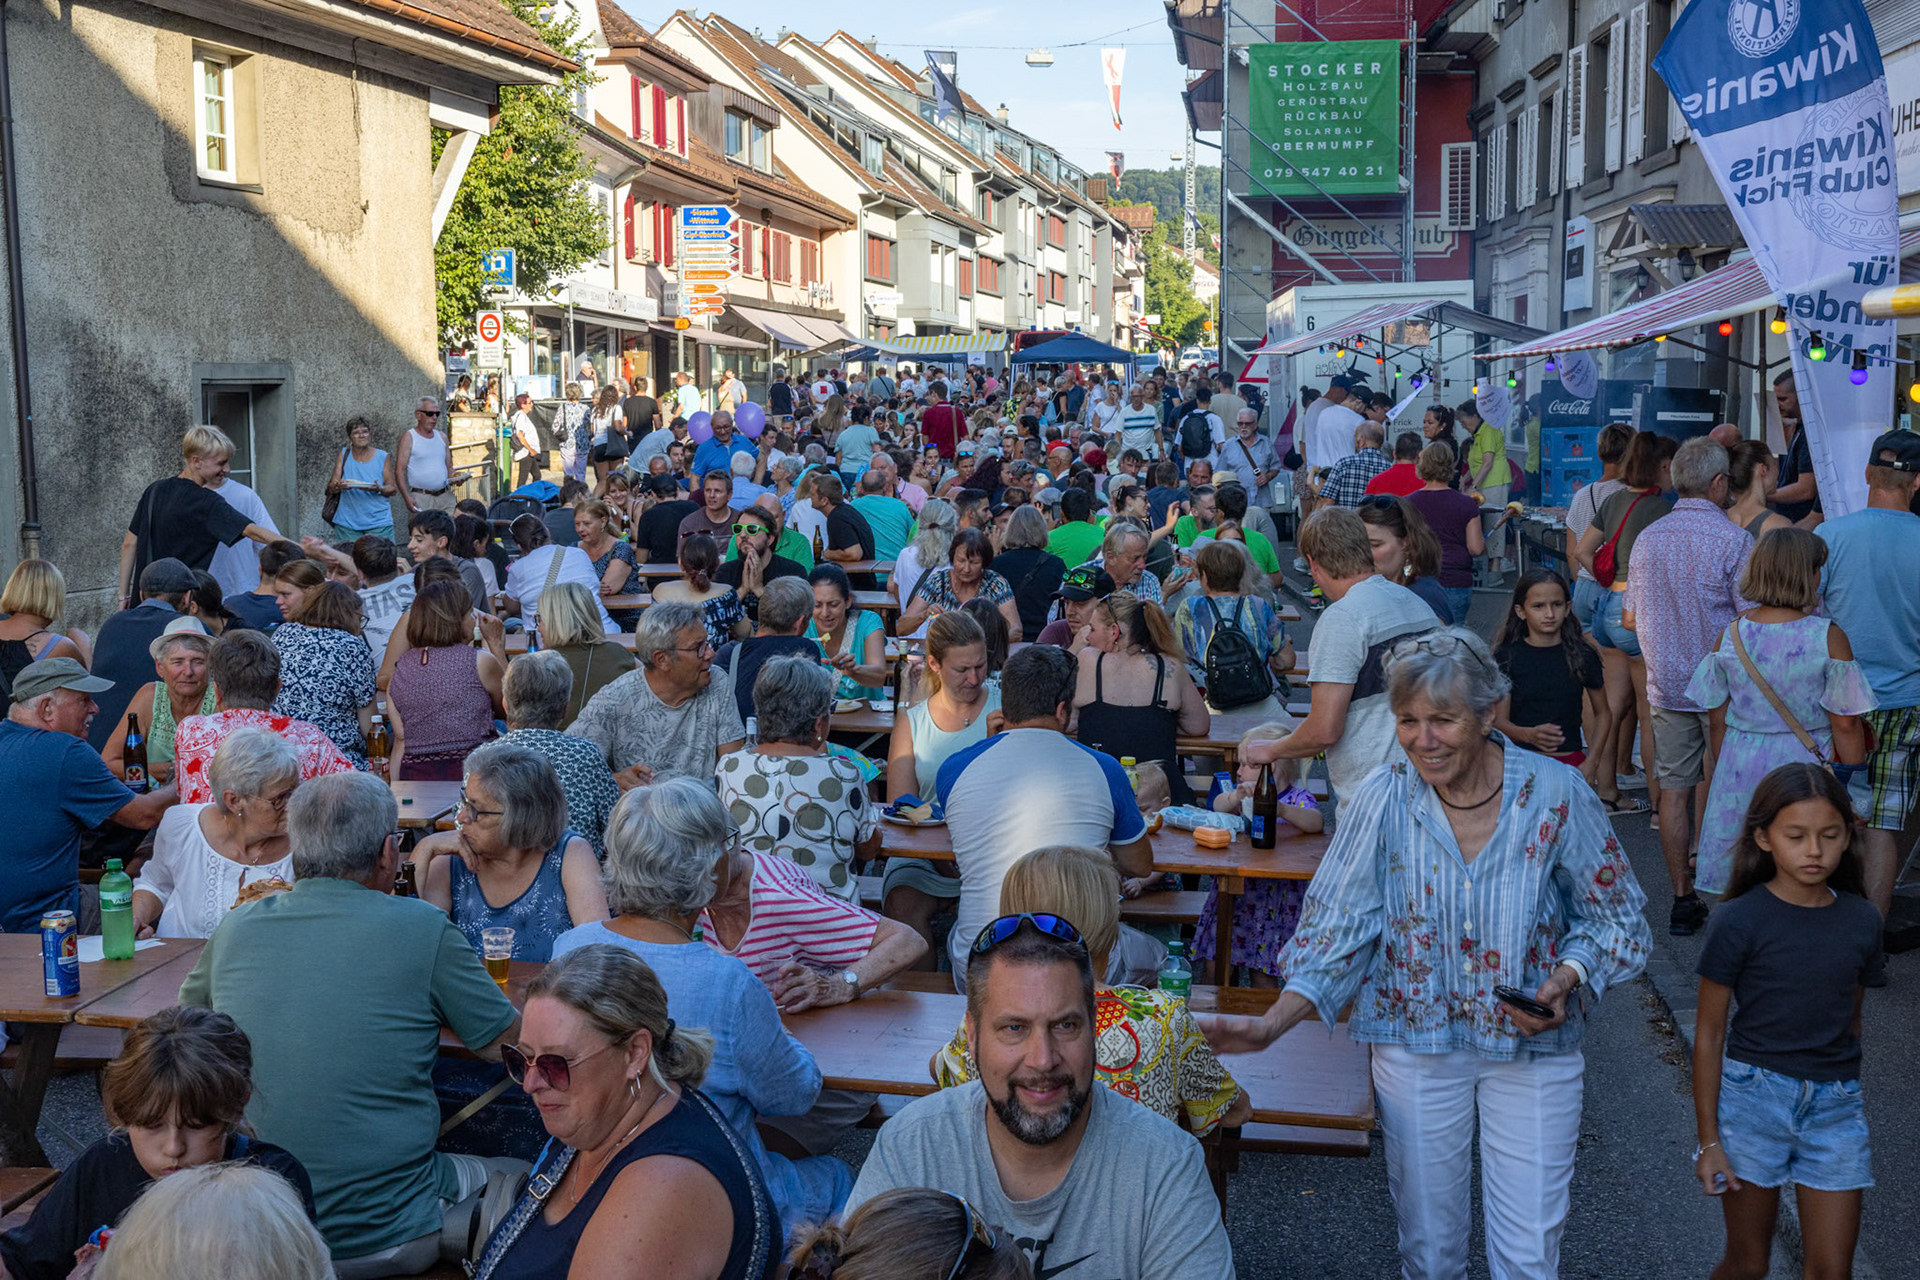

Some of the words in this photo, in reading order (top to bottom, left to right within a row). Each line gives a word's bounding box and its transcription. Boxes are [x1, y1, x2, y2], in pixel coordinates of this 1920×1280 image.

[1268, 62, 1381, 77] STOCKER
[1283, 81, 1363, 92] HOLZBAU
[1277, 97, 1368, 107] GERÜSTBAU
[1284, 111, 1362, 121] RÜCKBAU
[1284, 127, 1362, 136] SOLARBAU
[1272, 140, 1374, 151] OBERMUMPF
[1264, 168, 1293, 178] 079
[1301, 167, 1331, 177] 547
[1338, 166, 1358, 176] 40
[1365, 165, 1383, 176] 21
[1293, 224, 1385, 250] Güggeli
[1307, 315, 1315, 331] 6
[1393, 418, 1412, 426] Frick
